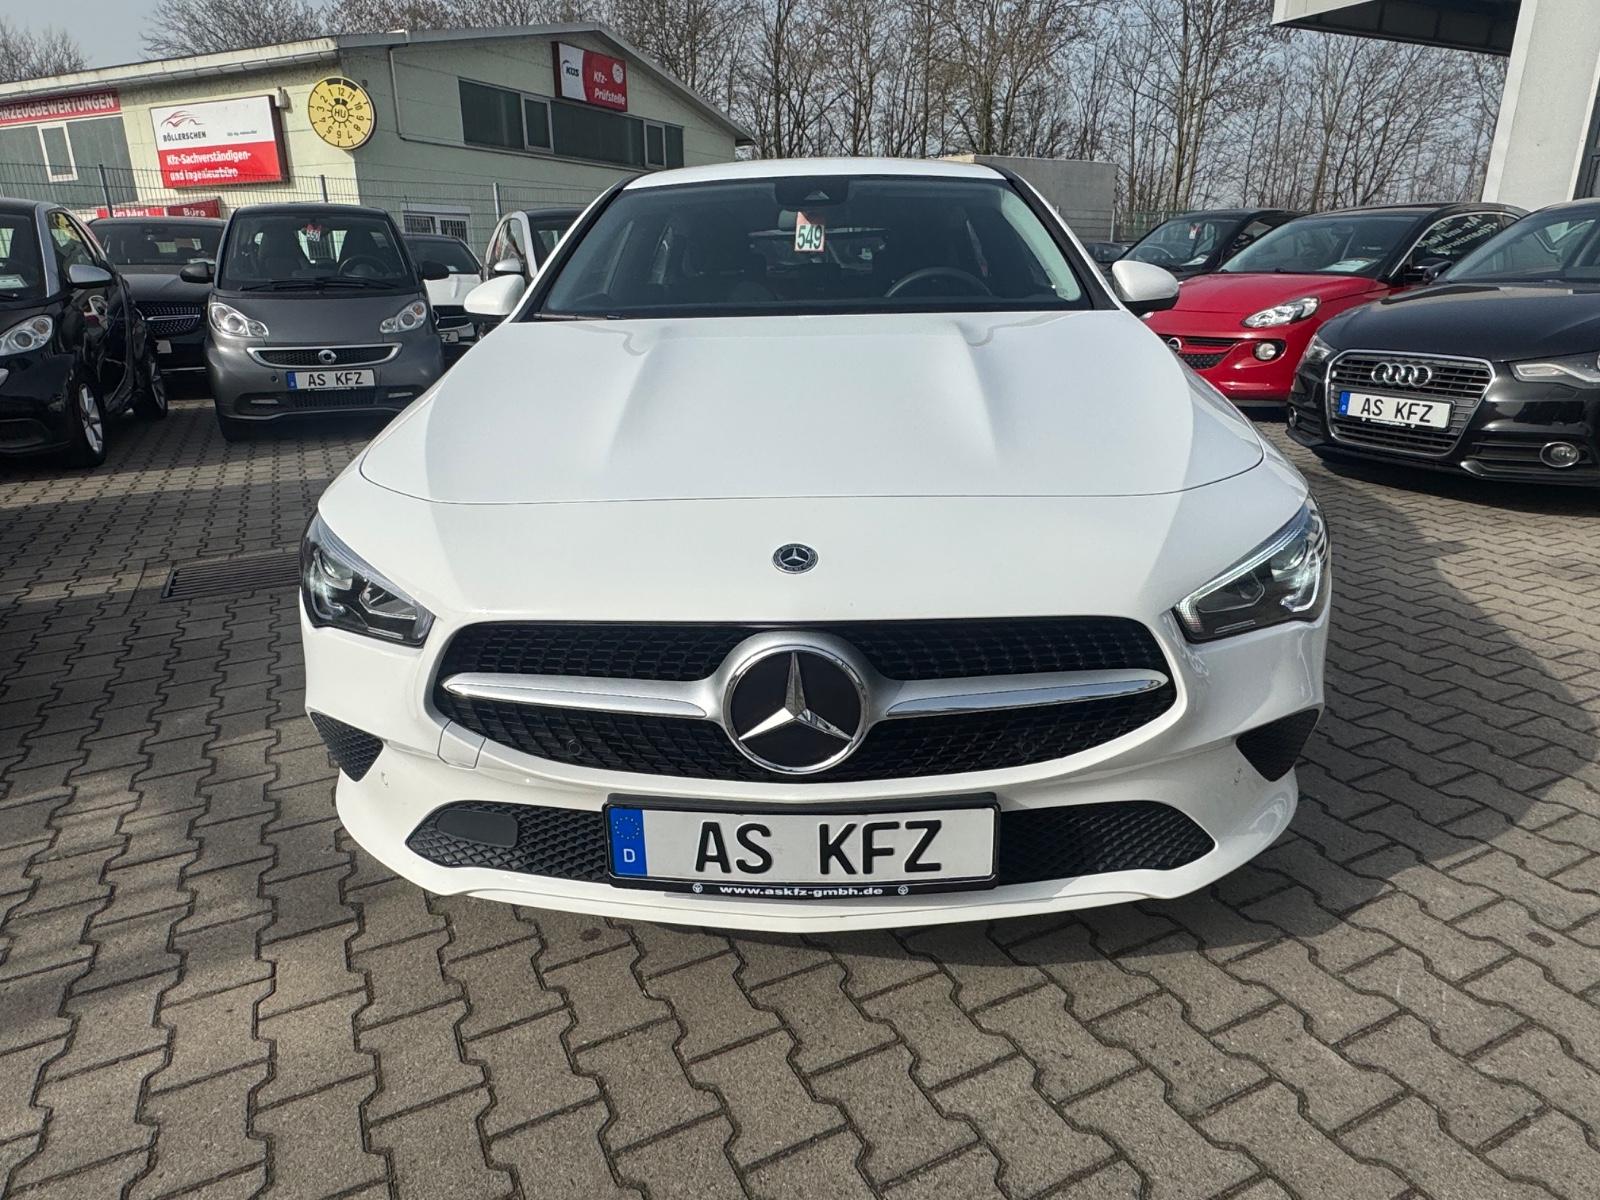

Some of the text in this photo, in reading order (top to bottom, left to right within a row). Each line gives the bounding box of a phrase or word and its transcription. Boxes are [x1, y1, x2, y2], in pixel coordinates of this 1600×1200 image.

[593, 71, 608, 84] Kfz-
[338, 86, 345, 96] 12
[348, 91, 355, 102] 11
[594, 87, 626, 105] Prüfstelle
[320, 95, 328, 104] 2
[354, 101, 363, 111] 10
[334, 108, 347, 118] HU
[166, 149, 252, 166] Kfz-Sachverständigen-
[170, 167, 239, 182] und Ingenieurbüro
[183, 207, 206, 216] Büro
[797, 225, 822, 250] 549
[308, 371, 363, 387] AS KFZ
[1360, 397, 1384, 417] AS
[1394, 401, 1434, 423] KFZ
[623, 819, 942, 875] D AS KFZ
[719, 884, 883, 898] www.askfz-gmbh.de
